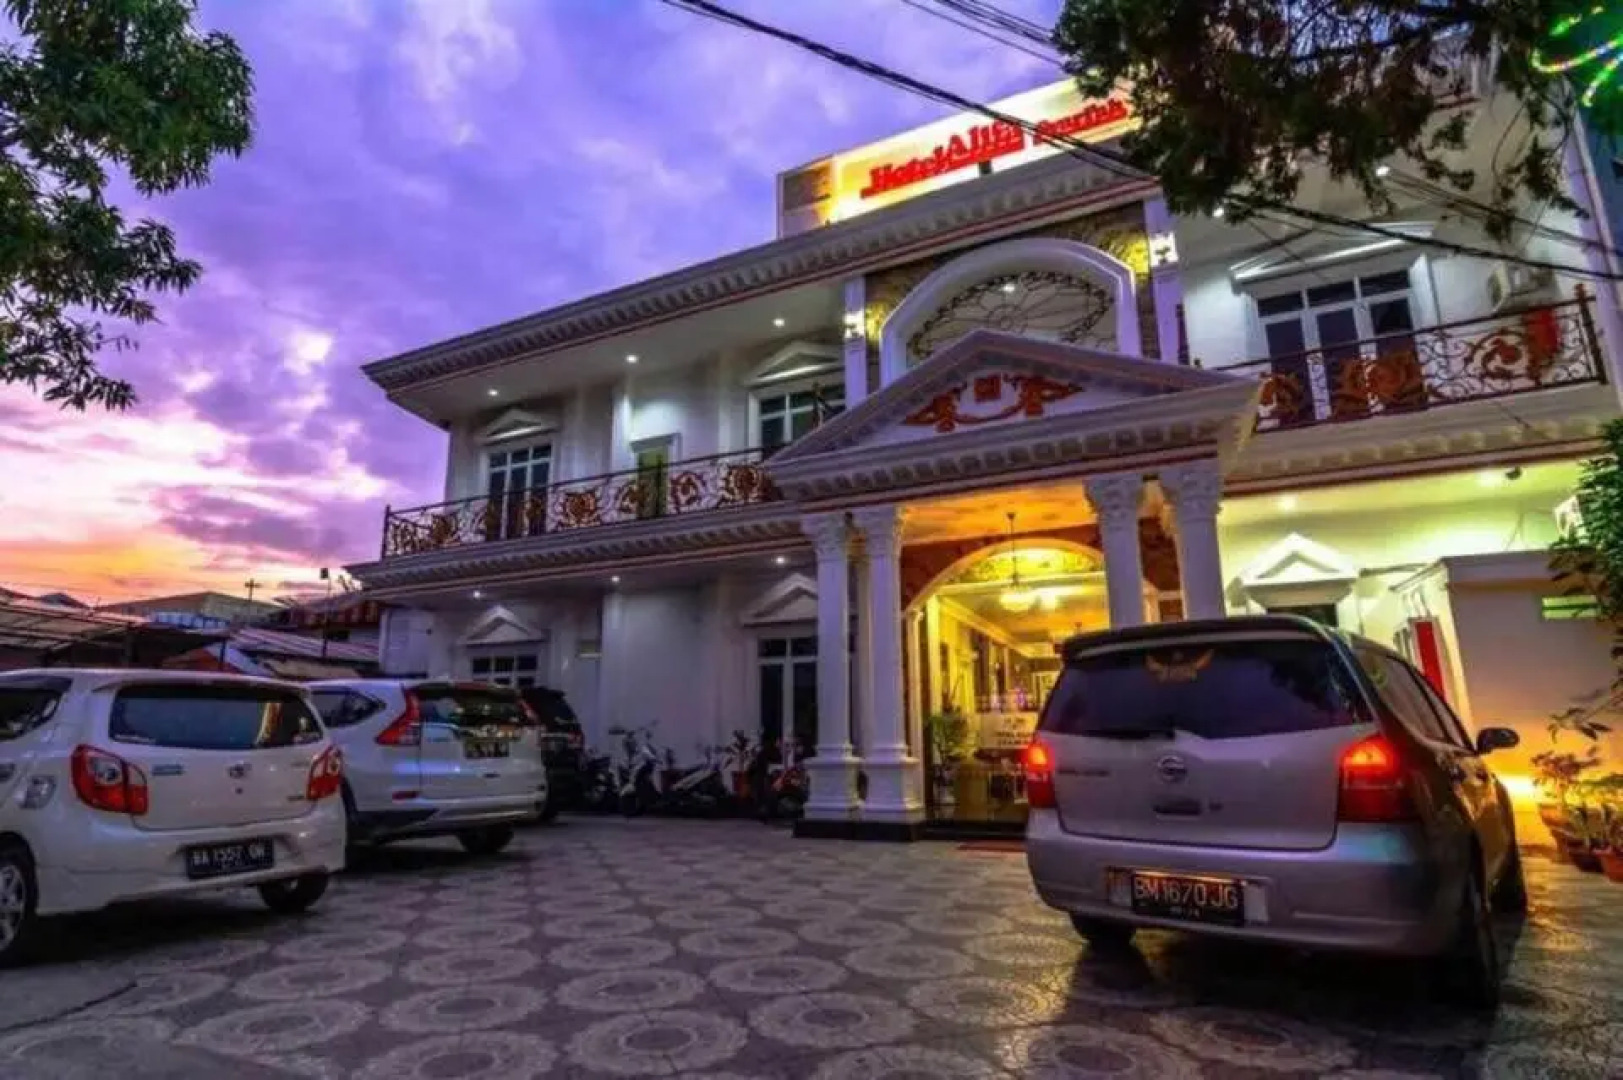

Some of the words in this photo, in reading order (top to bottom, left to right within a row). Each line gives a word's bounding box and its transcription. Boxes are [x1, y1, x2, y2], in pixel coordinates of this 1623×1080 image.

[864, 145, 948, 196] Hotel
[1135, 877, 1160, 900] BM
[1163, 880, 1207, 905] 1670
[1211, 884, 1239, 909] JG
